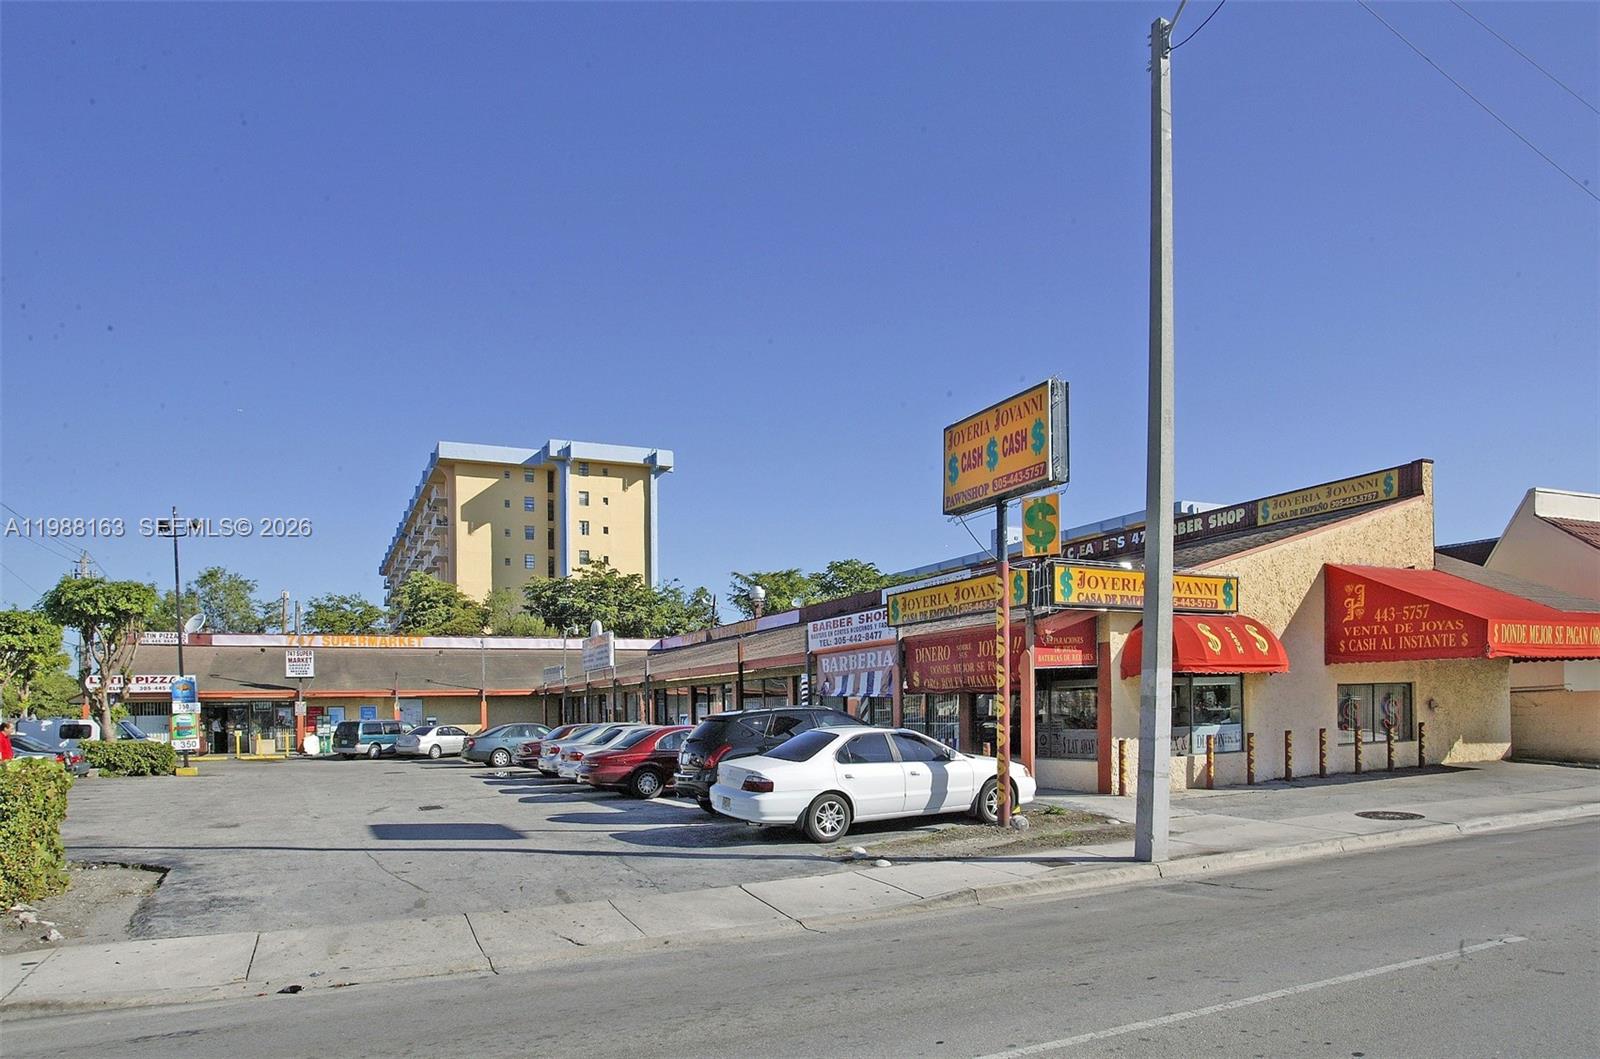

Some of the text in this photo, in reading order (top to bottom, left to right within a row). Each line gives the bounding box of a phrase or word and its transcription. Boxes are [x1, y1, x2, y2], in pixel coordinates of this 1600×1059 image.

[947, 394, 1043, 451] JOYERIA JOVANNI
[961, 445, 983, 473] CASH
[1002, 428, 1028, 458] CASH
[945, 462, 1045, 509] PAWNSHOP 305-443-5757
[1272, 478, 1379, 510] JOYERIA JOVANNI
[1174, 518, 1203, 536] BER
[1208, 508, 1246, 529] SHOP
[1272, 510, 1288, 521] CASA
[1289, 508, 1298, 517] DE
[901, 593, 949, 613] JOYERIA
[953, 582, 997, 602] JOVAN
[1173, 581, 1218, 596] VANNI
[1077, 592, 1217, 608] CASA DE EMPE 5-443-5757
[902, 612, 919, 623] CASA
[920, 610, 928, 620] DE
[1374, 603, 1430, 622] 443-5757
[812, 617, 853, 632] BARBER
[834, 628, 850, 636] CORTES
[1343, 619, 1464, 637] VENTA DE JOYAS
[1501, 623, 1527, 644] DONDE
[1529, 624, 1553, 645] MEJOR
[1555, 625, 1564, 645] SE
[1566, 626, 1589, 645] PAGAN
[1590, 626, 1600, 645] OR
[322, 635, 424, 647] SUPERMARKET
[819, 631, 882, 647] TEL: 305-442-8477
[1224, 626, 1245, 654] CASH
[1348, 638, 1376, 652] CASH
[1380, 637, 1395, 650] AL
[1400, 633, 1456, 650] INSTANTE
[915, 644, 951, 663] DINERO
[977, 640, 997, 658] JOY
[821, 650, 894, 673] BARBERIA
[976, 661, 985, 672] SE
